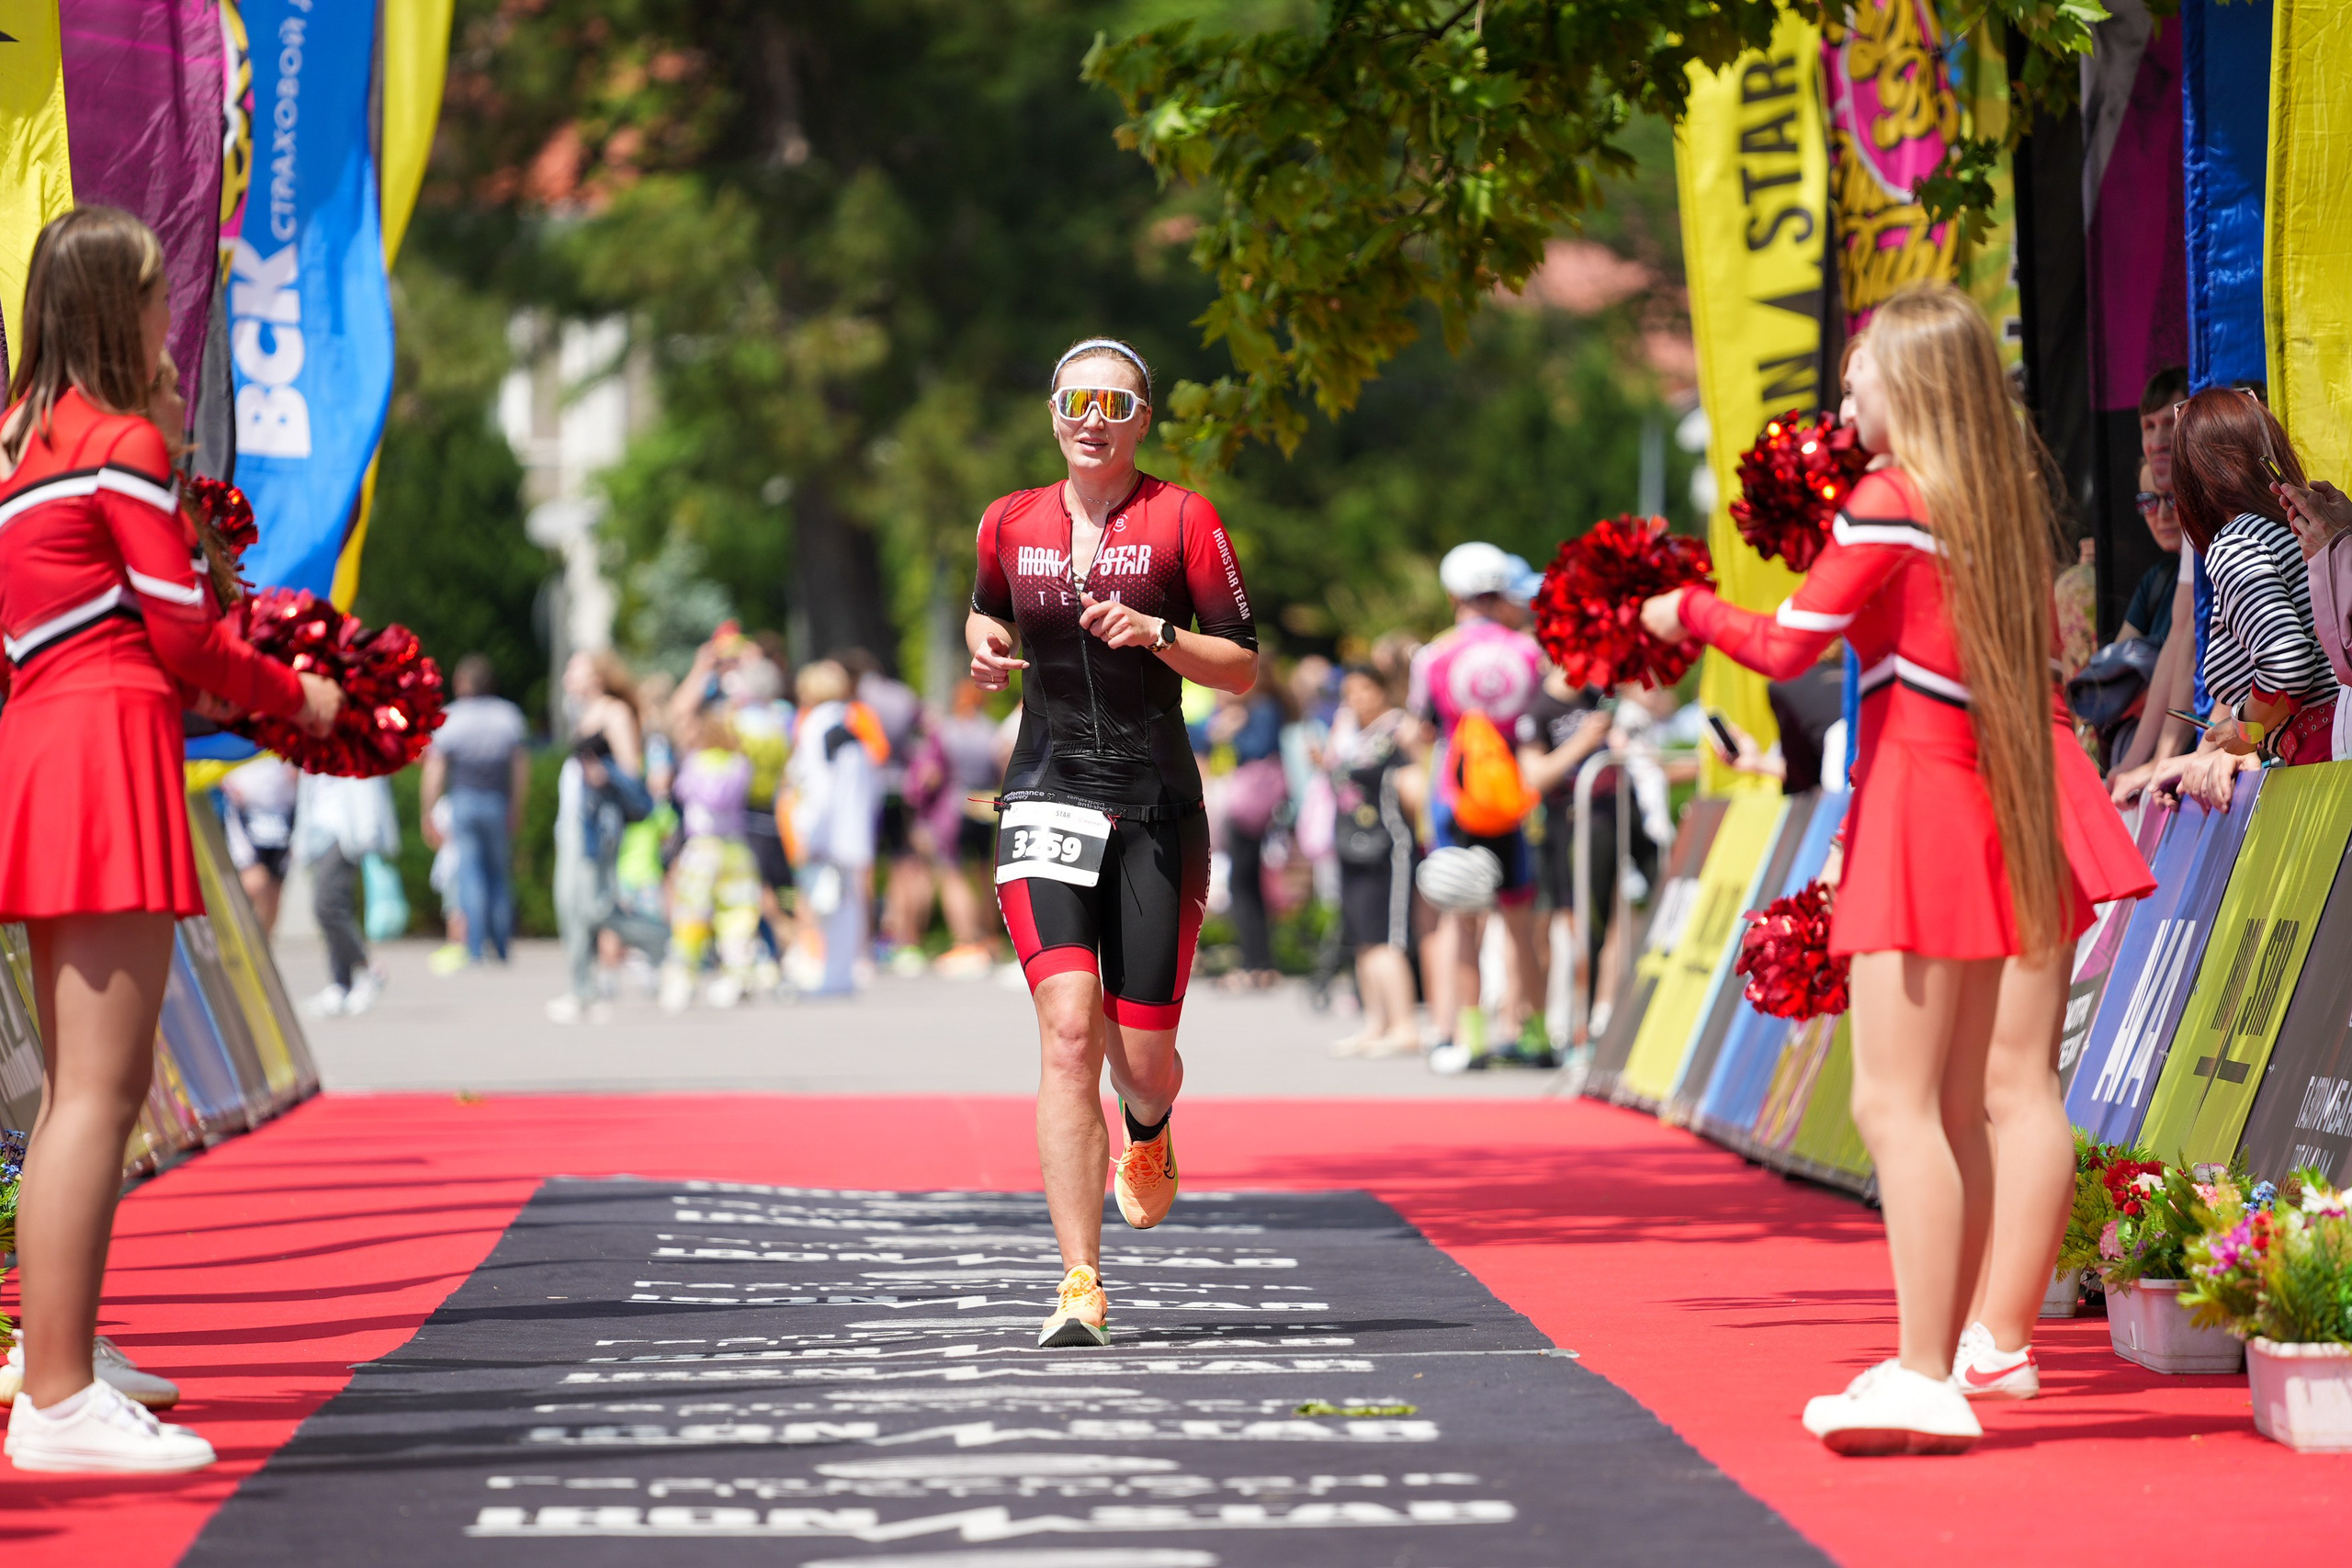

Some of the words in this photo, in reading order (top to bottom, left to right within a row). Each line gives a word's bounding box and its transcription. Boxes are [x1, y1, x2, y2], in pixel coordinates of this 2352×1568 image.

[270, 16, 308, 243] СТРАХОВОЙ
[1740, 53, 1814, 252] STAR
[232, 240, 311, 458] ВСК
[1018, 546, 1060, 578] IRON
[1099, 544, 1152, 576] STAR
[1212, 527, 1238, 588] IRONSTAR
[1233, 586, 1250, 620] TEAM
[1003, 790, 1045, 801] performance
[1056, 809, 1071, 819] STAR
[1012, 829, 1082, 863] 3259
[2237, 918, 2300, 1036] STAR
